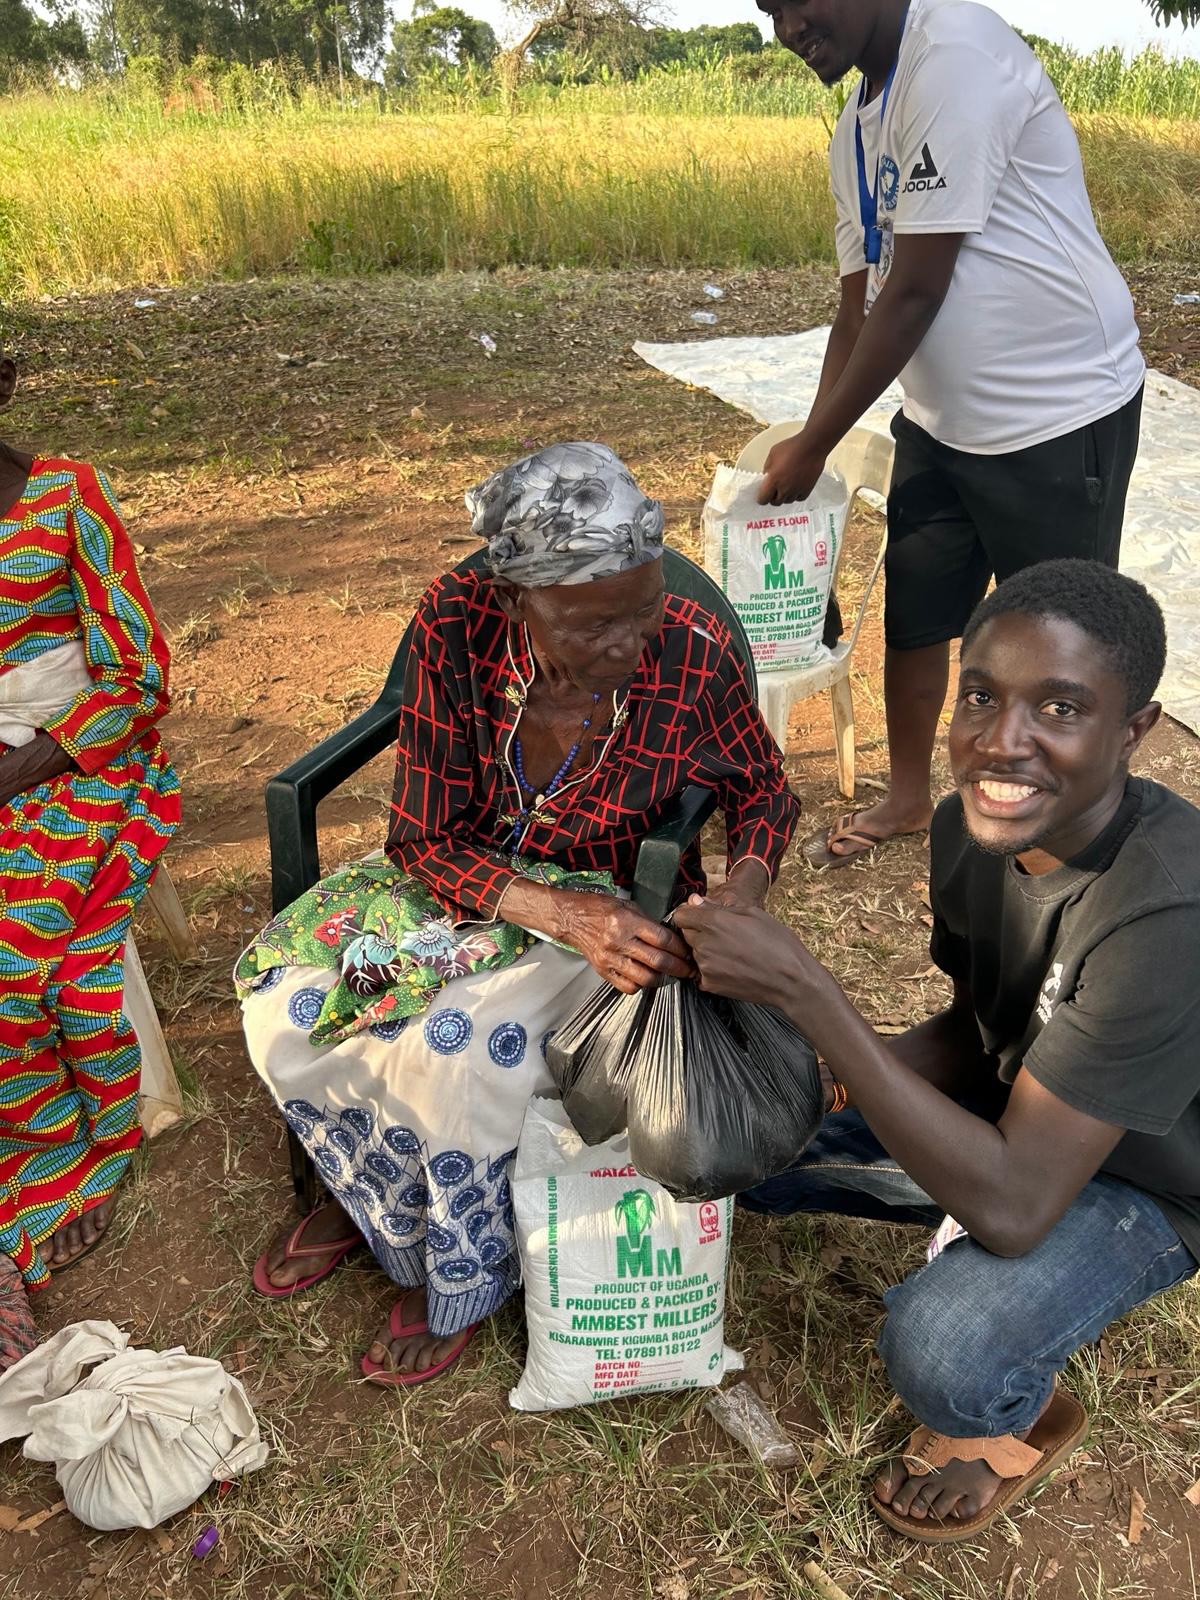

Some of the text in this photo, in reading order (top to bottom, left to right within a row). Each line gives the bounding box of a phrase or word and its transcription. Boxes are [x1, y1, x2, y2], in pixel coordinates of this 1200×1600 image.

[902, 177, 947, 193] JOOLA
[747, 516, 809, 529] MAIZE FLOUR
[750, 586, 818, 600] PRODUCT OF UGANDA
[732, 602, 776, 611] PRODUCED
[778, 601, 784, 609] &
[786, 596, 814, 608] PACKED
[785, 605, 822, 621] MILLERS
[750, 634, 766, 642] TEL:
[590, 1166, 637, 1177] MAIZE
[548, 1193, 558, 1211] FOR
[548, 1212, 558, 1246] HUMAN
[549, 1248, 559, 1308] CONSUMPTION
[594, 1272, 709, 1294] PRODUCT OF UGANDA
[566, 1298, 636, 1310] PRODUCED
[641, 1296, 650, 1309] &
[655, 1289, 703, 1308] PACKED
[572, 1298, 717, 1331] MMBEST MILLERS
[549, 1331, 619, 1347] KISARABWIRE
[622, 1333, 668, 1346] KIGUMBA
[672, 1328, 698, 1341] ROAD
[596, 1338, 700, 1360] TEL: 0789118122
[595, 1362, 625, 1371] BATCH
[594, 1372, 614, 1380] MFG
[593, 1390, 615, 1399] Net
[620, 1382, 666, 1395] weight:
[671, 1380, 678, 1388] 5
[594, 1381, 611, 1389] EXP
